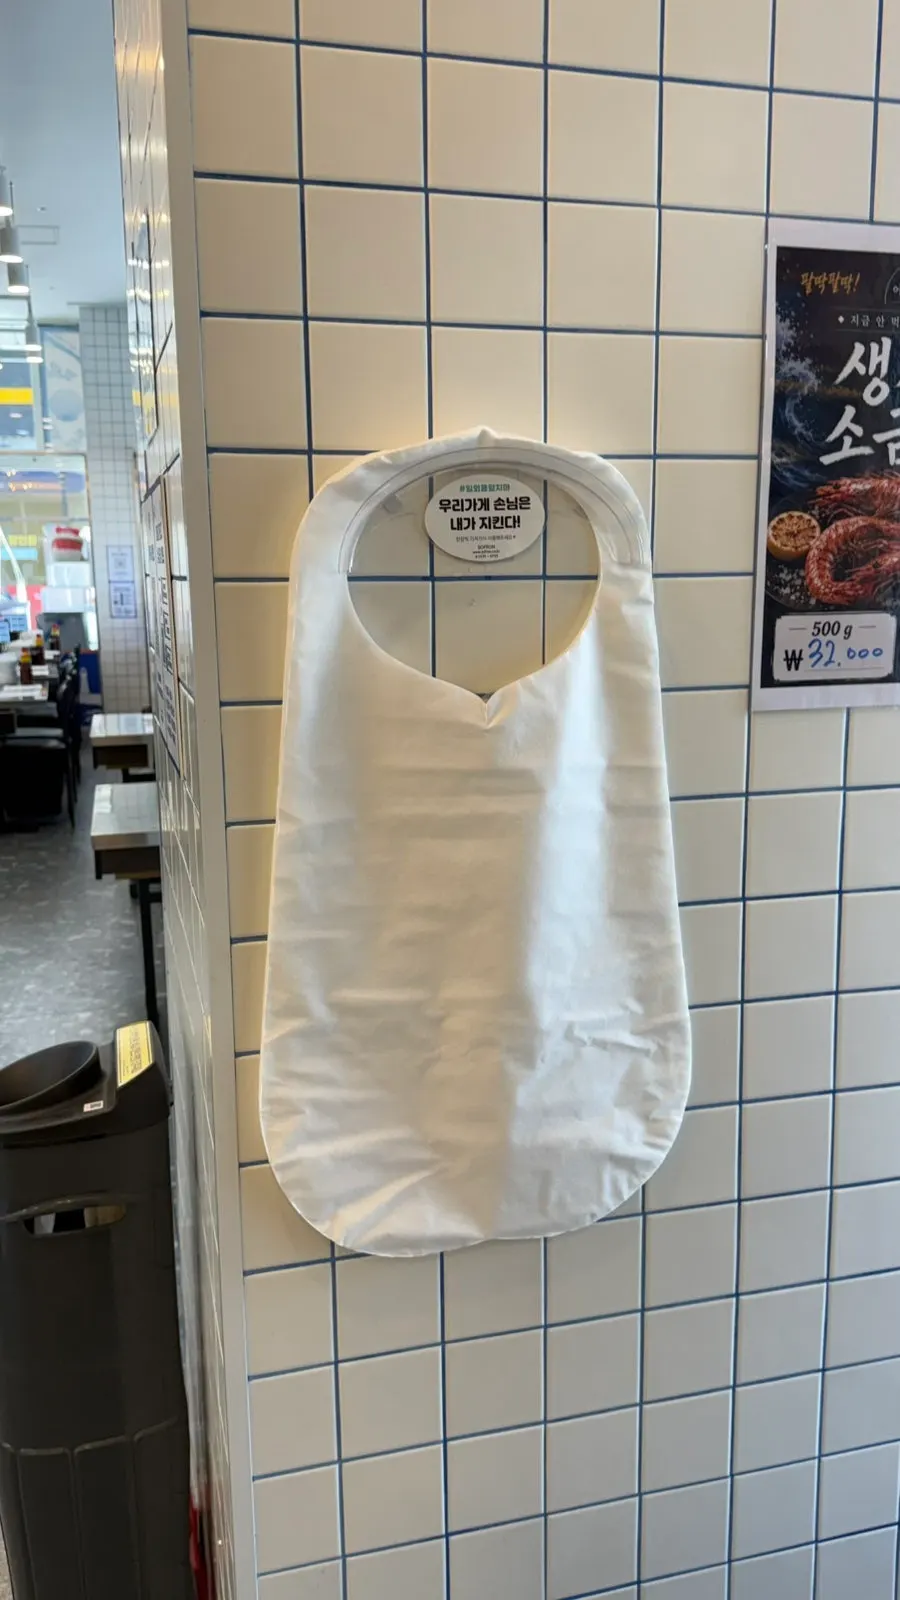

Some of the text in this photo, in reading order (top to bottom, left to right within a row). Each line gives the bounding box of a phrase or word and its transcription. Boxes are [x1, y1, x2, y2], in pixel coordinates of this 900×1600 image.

[801, 271, 861, 296] 팔딱팔딱!
[850, 314, 870, 328] 지금
[876, 315, 885, 328] 안
[438, 496, 531, 513] 우리가게 손님은
[450, 515, 521, 531] 내가 지킨다!
